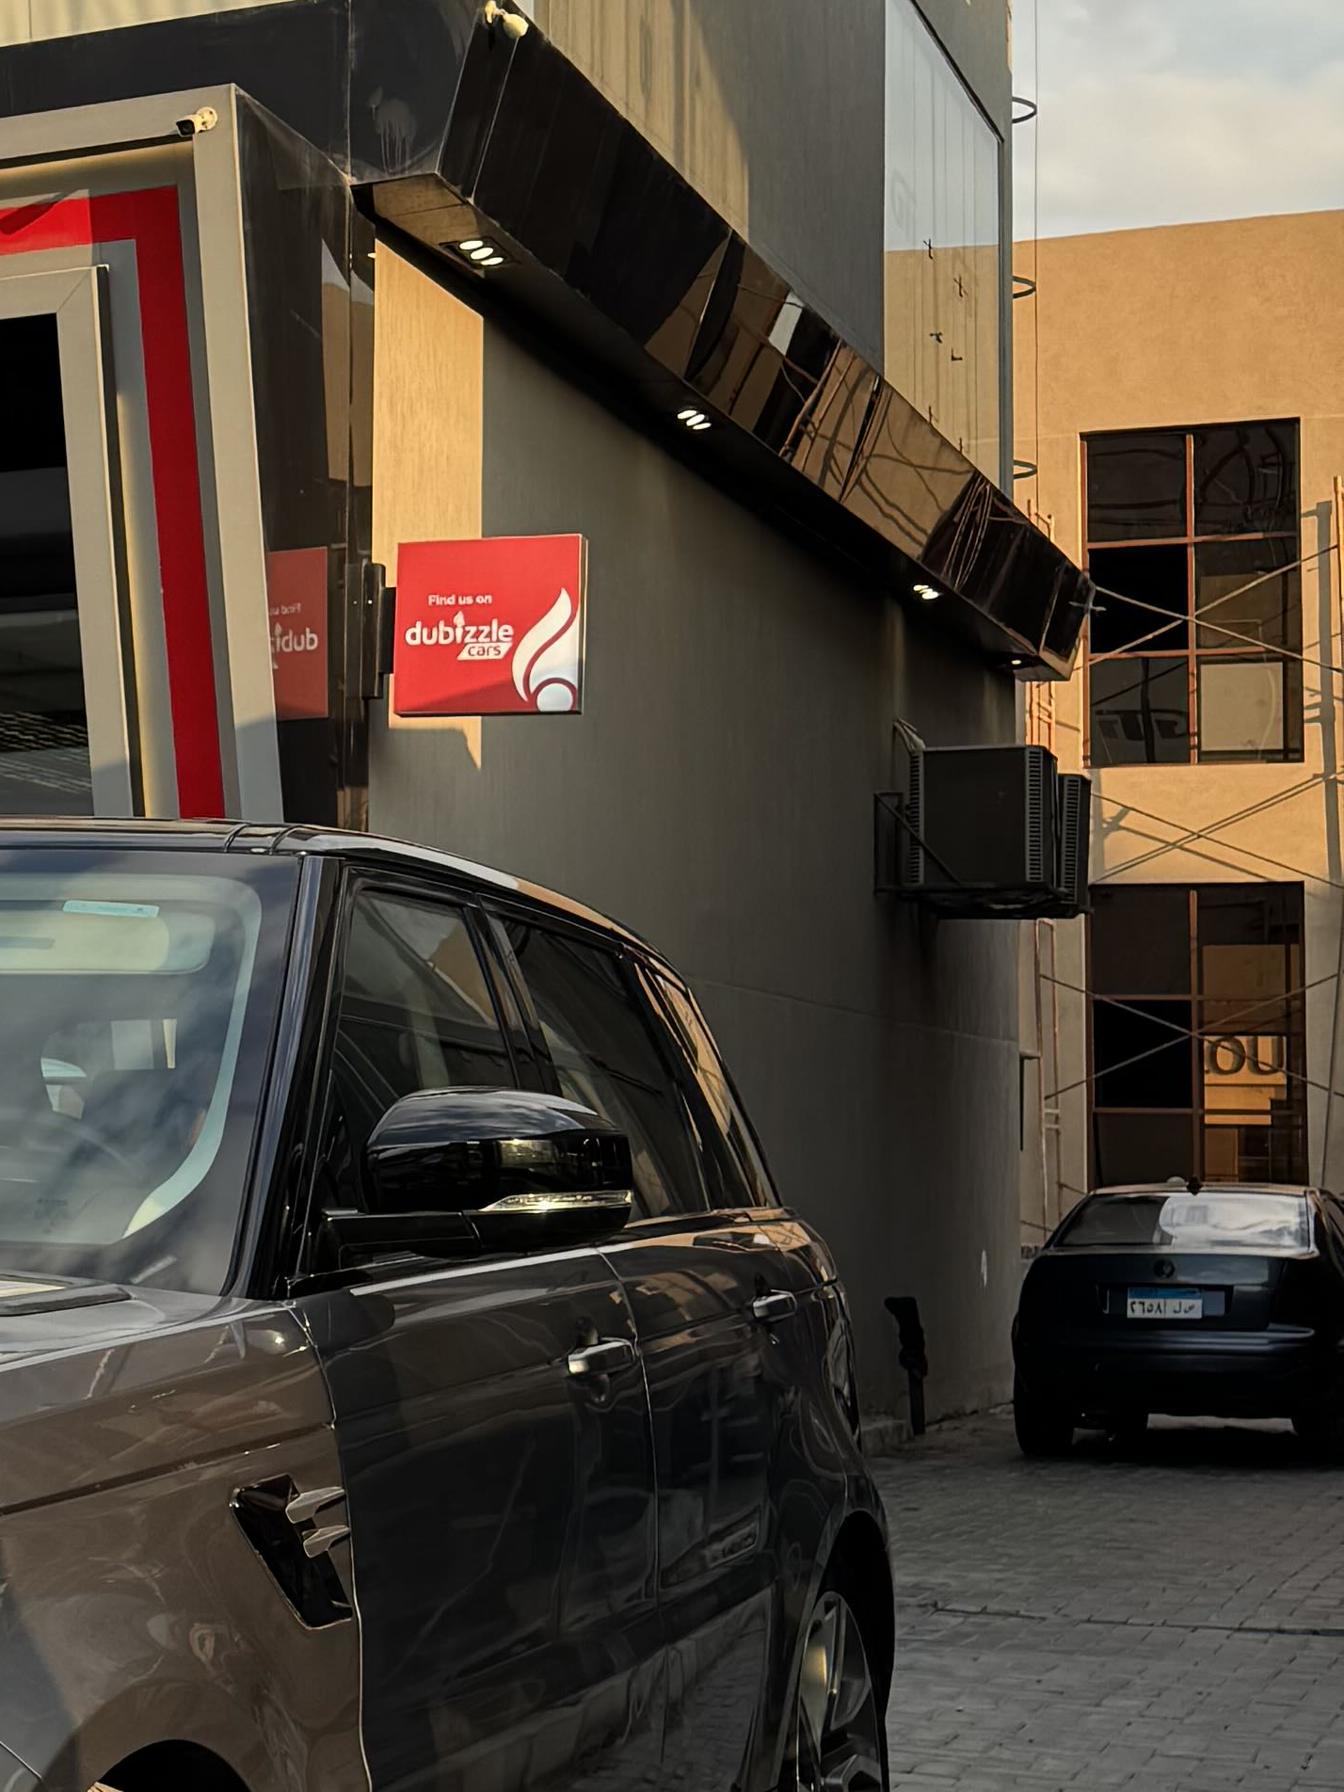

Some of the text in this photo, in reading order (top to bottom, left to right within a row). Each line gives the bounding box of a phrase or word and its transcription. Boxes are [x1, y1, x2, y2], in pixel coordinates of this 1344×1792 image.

[428, 594, 493, 606] Find us on
[404, 610, 514, 646] dubizzle
[467, 645, 502, 657] cars
